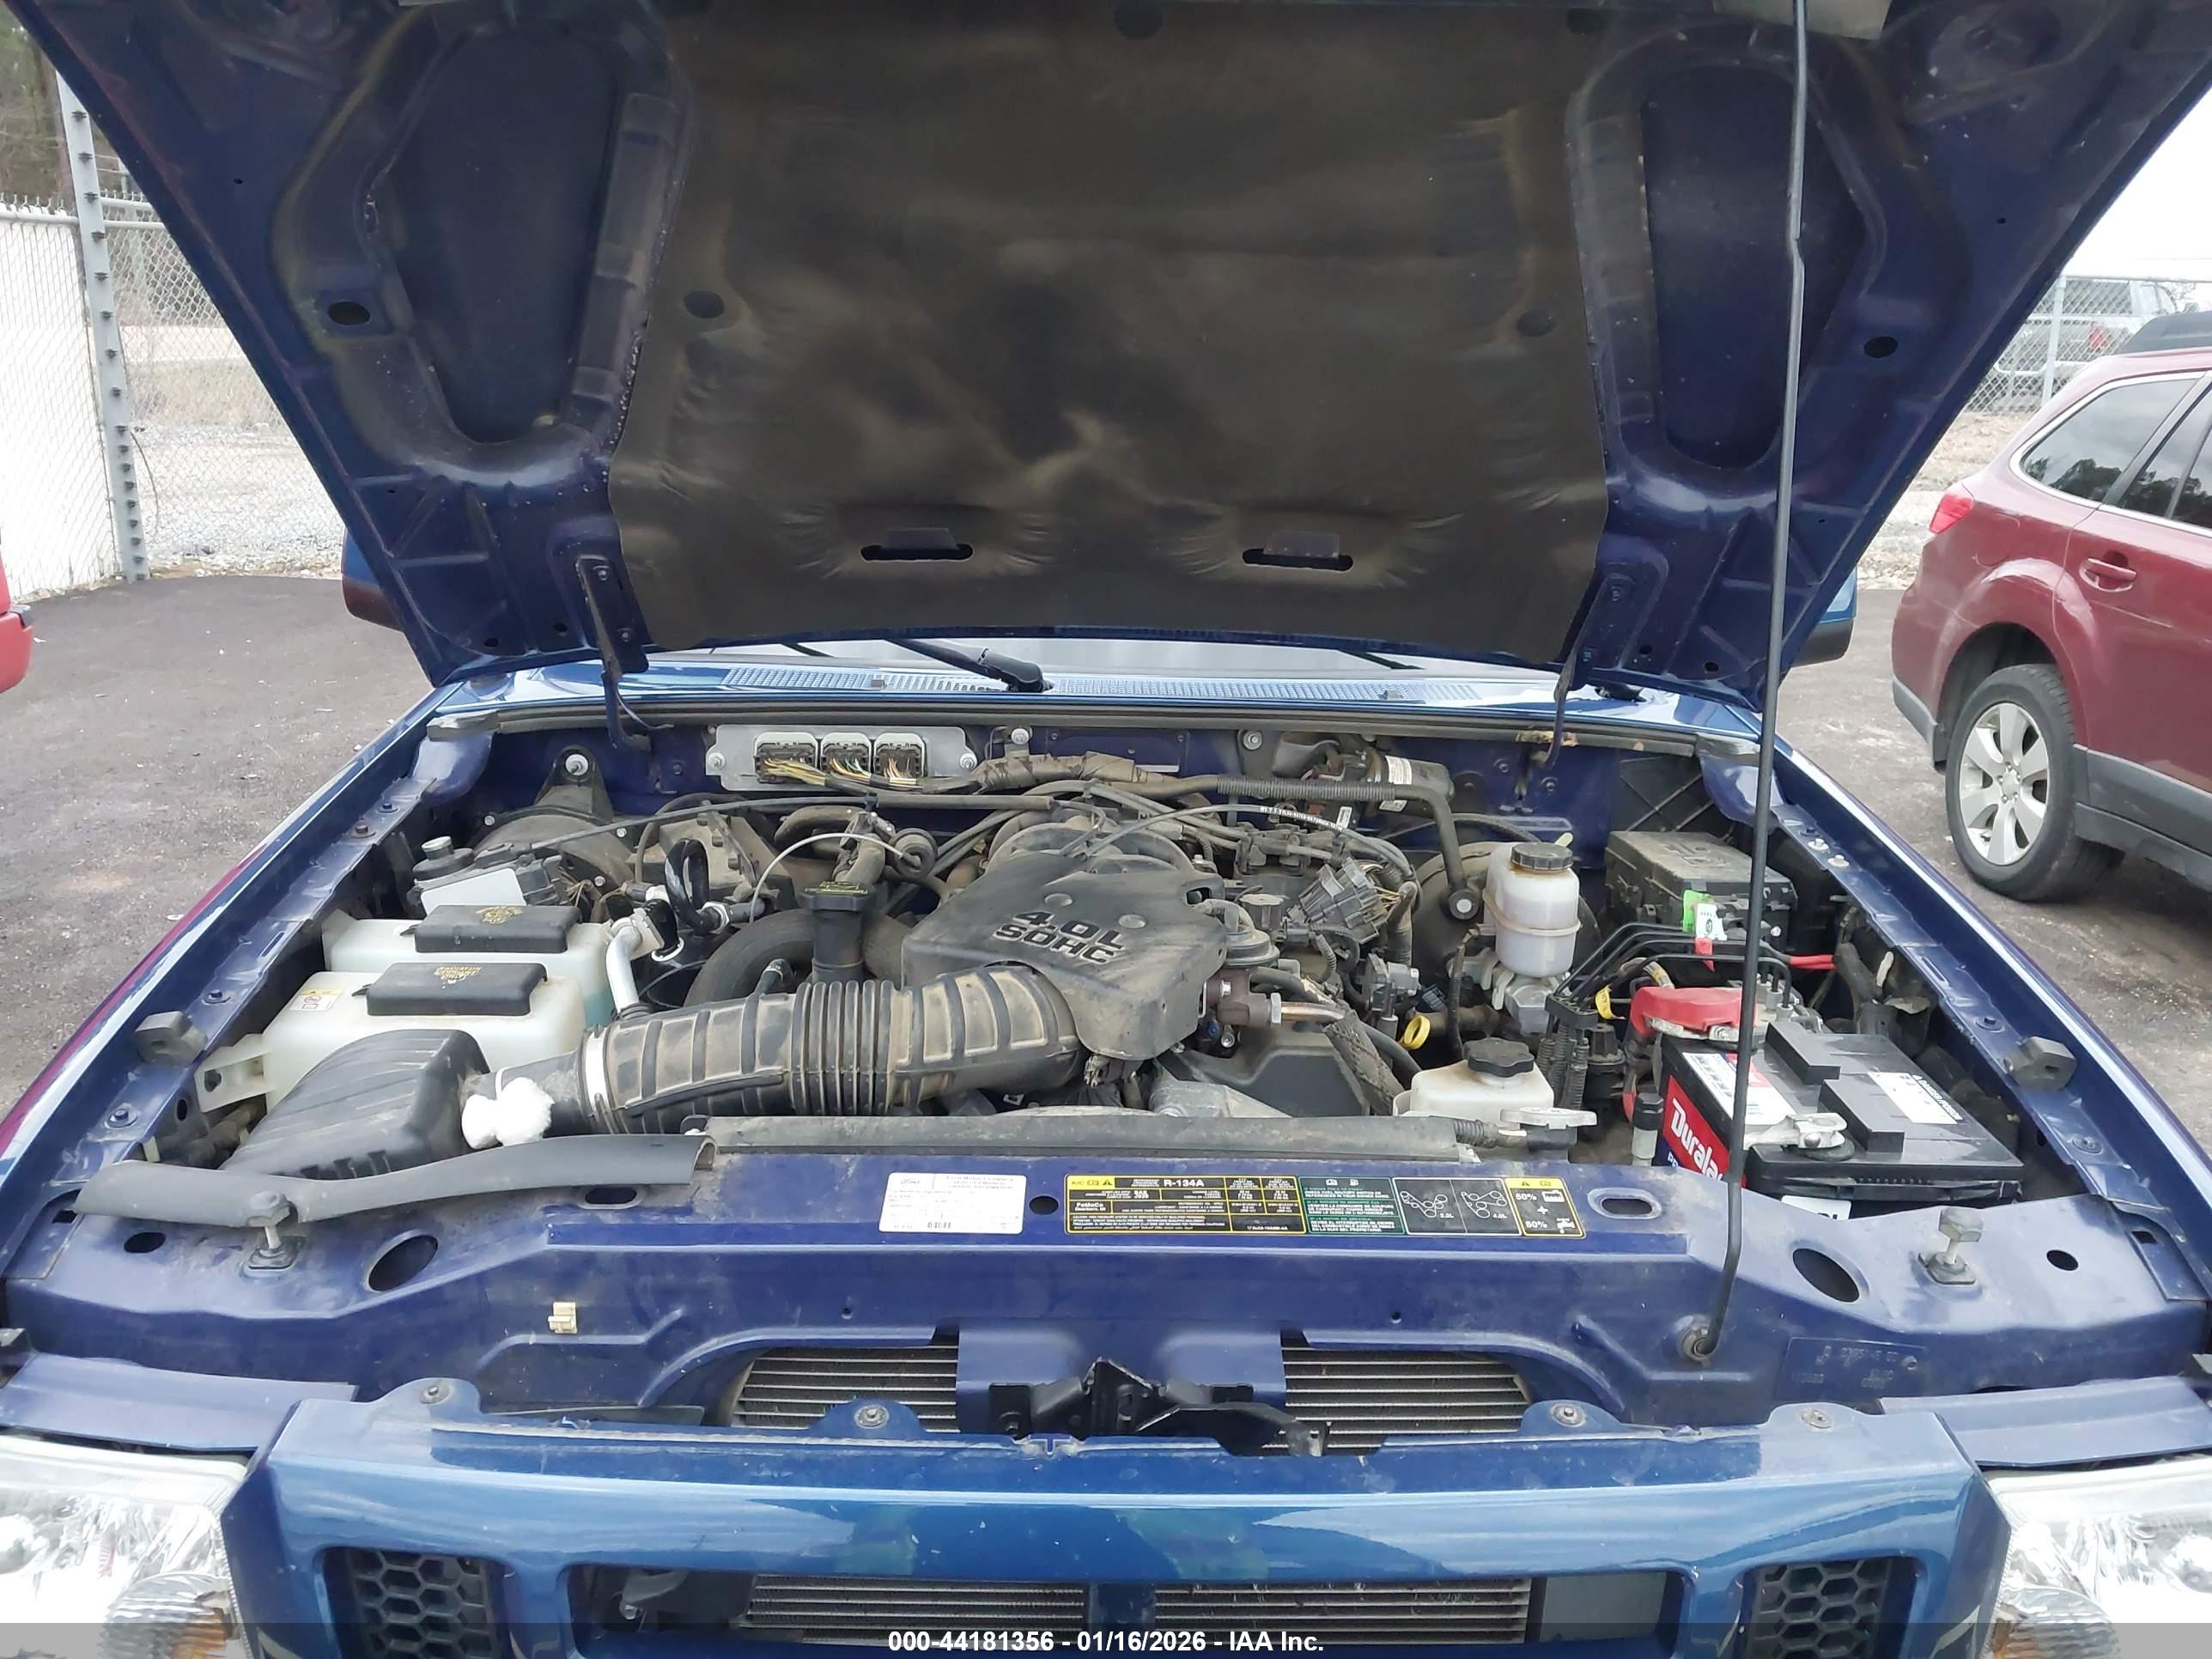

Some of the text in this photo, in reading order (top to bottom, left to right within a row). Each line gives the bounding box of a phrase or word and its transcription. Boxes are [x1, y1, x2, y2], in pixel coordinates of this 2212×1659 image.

[993, 924, 1117, 965] SOHC
[1013, 909, 1127, 951] 4.0L
[1670, 1097, 1723, 1181] Durala
